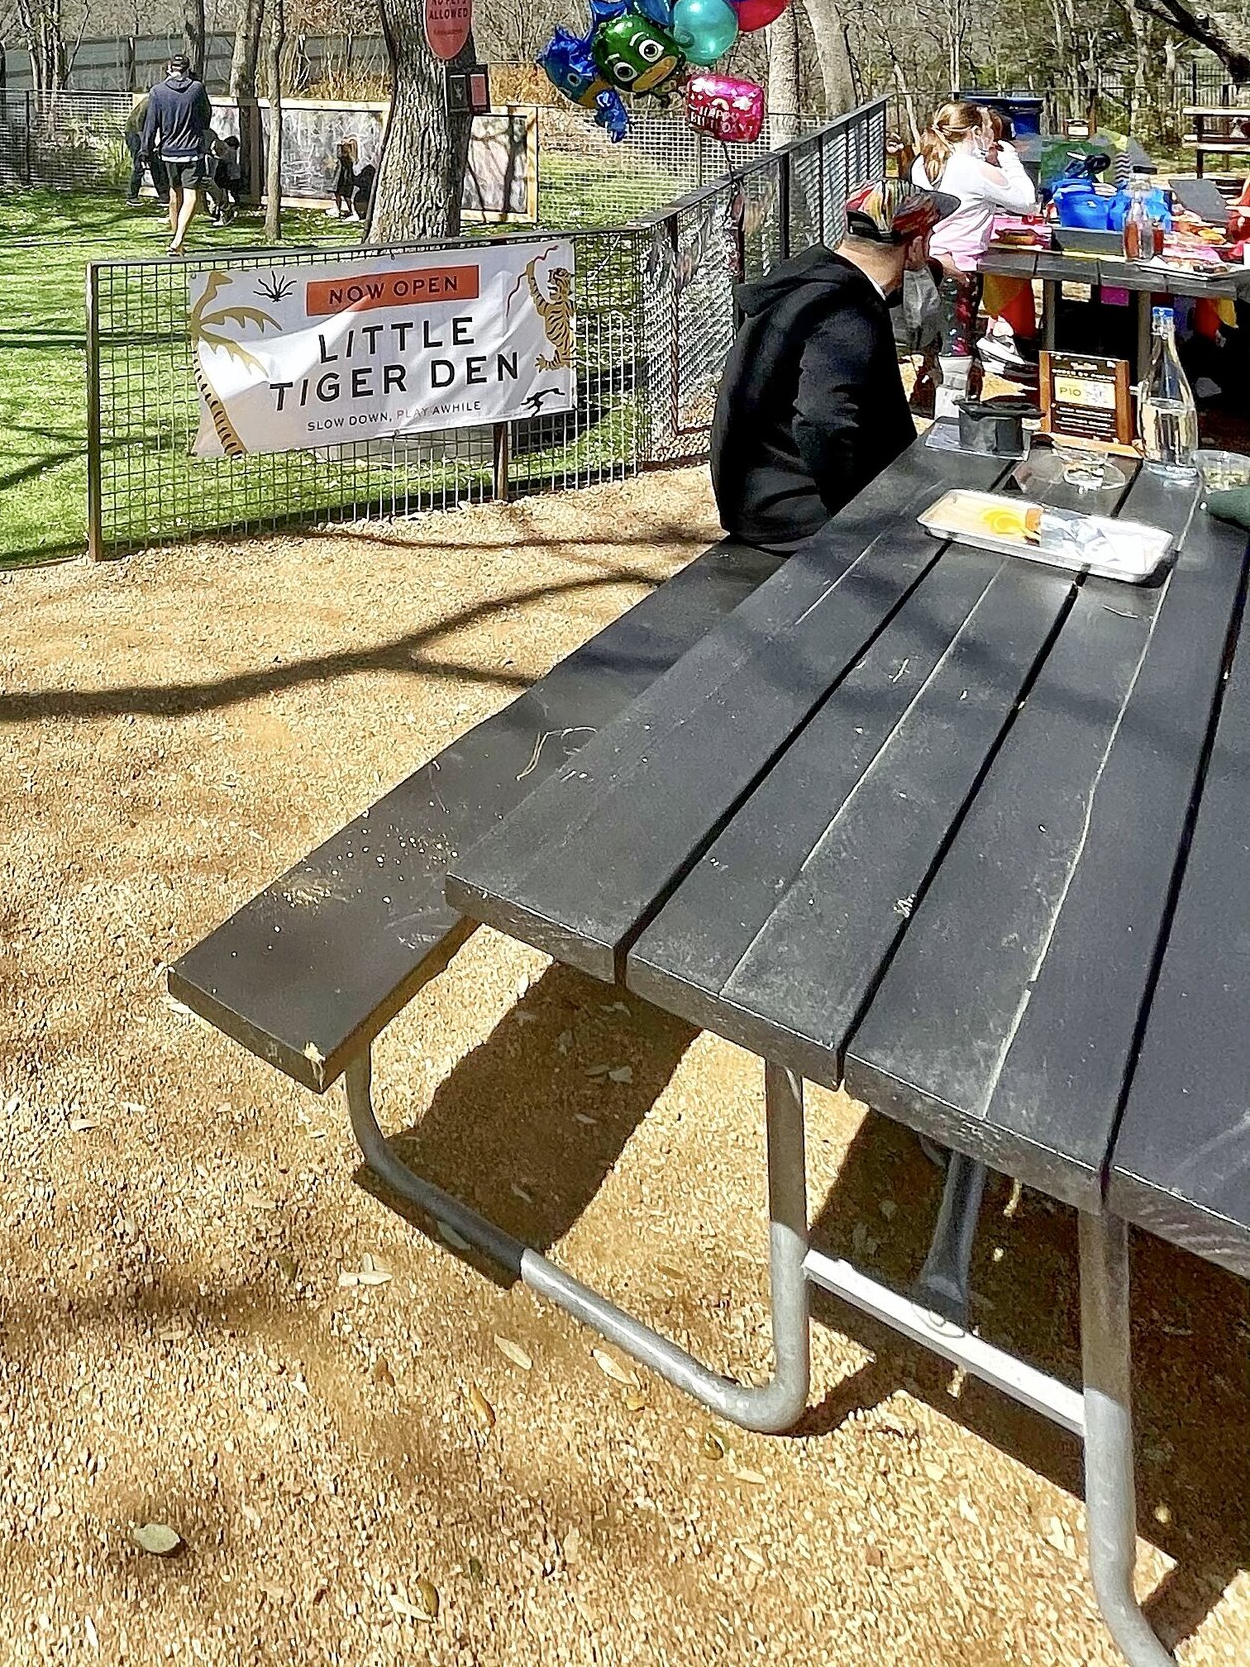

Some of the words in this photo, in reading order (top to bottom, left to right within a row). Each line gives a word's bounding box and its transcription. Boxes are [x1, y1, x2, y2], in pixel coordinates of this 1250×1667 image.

[429, 7, 468, 20] ALLOWED
[329, 283, 385, 305] NOW
[393, 275, 458, 297] OPEN
[318, 316, 475, 363] LITTLE
[269, 364, 407, 411] TIGER
[430, 351, 519, 388] DEN
[307, 417, 345, 432] SLOW
[349, 411, 393, 426] DOWN,
[396, 407, 429, 421] PLAY
[432, 400, 481, 416] AWHILE
